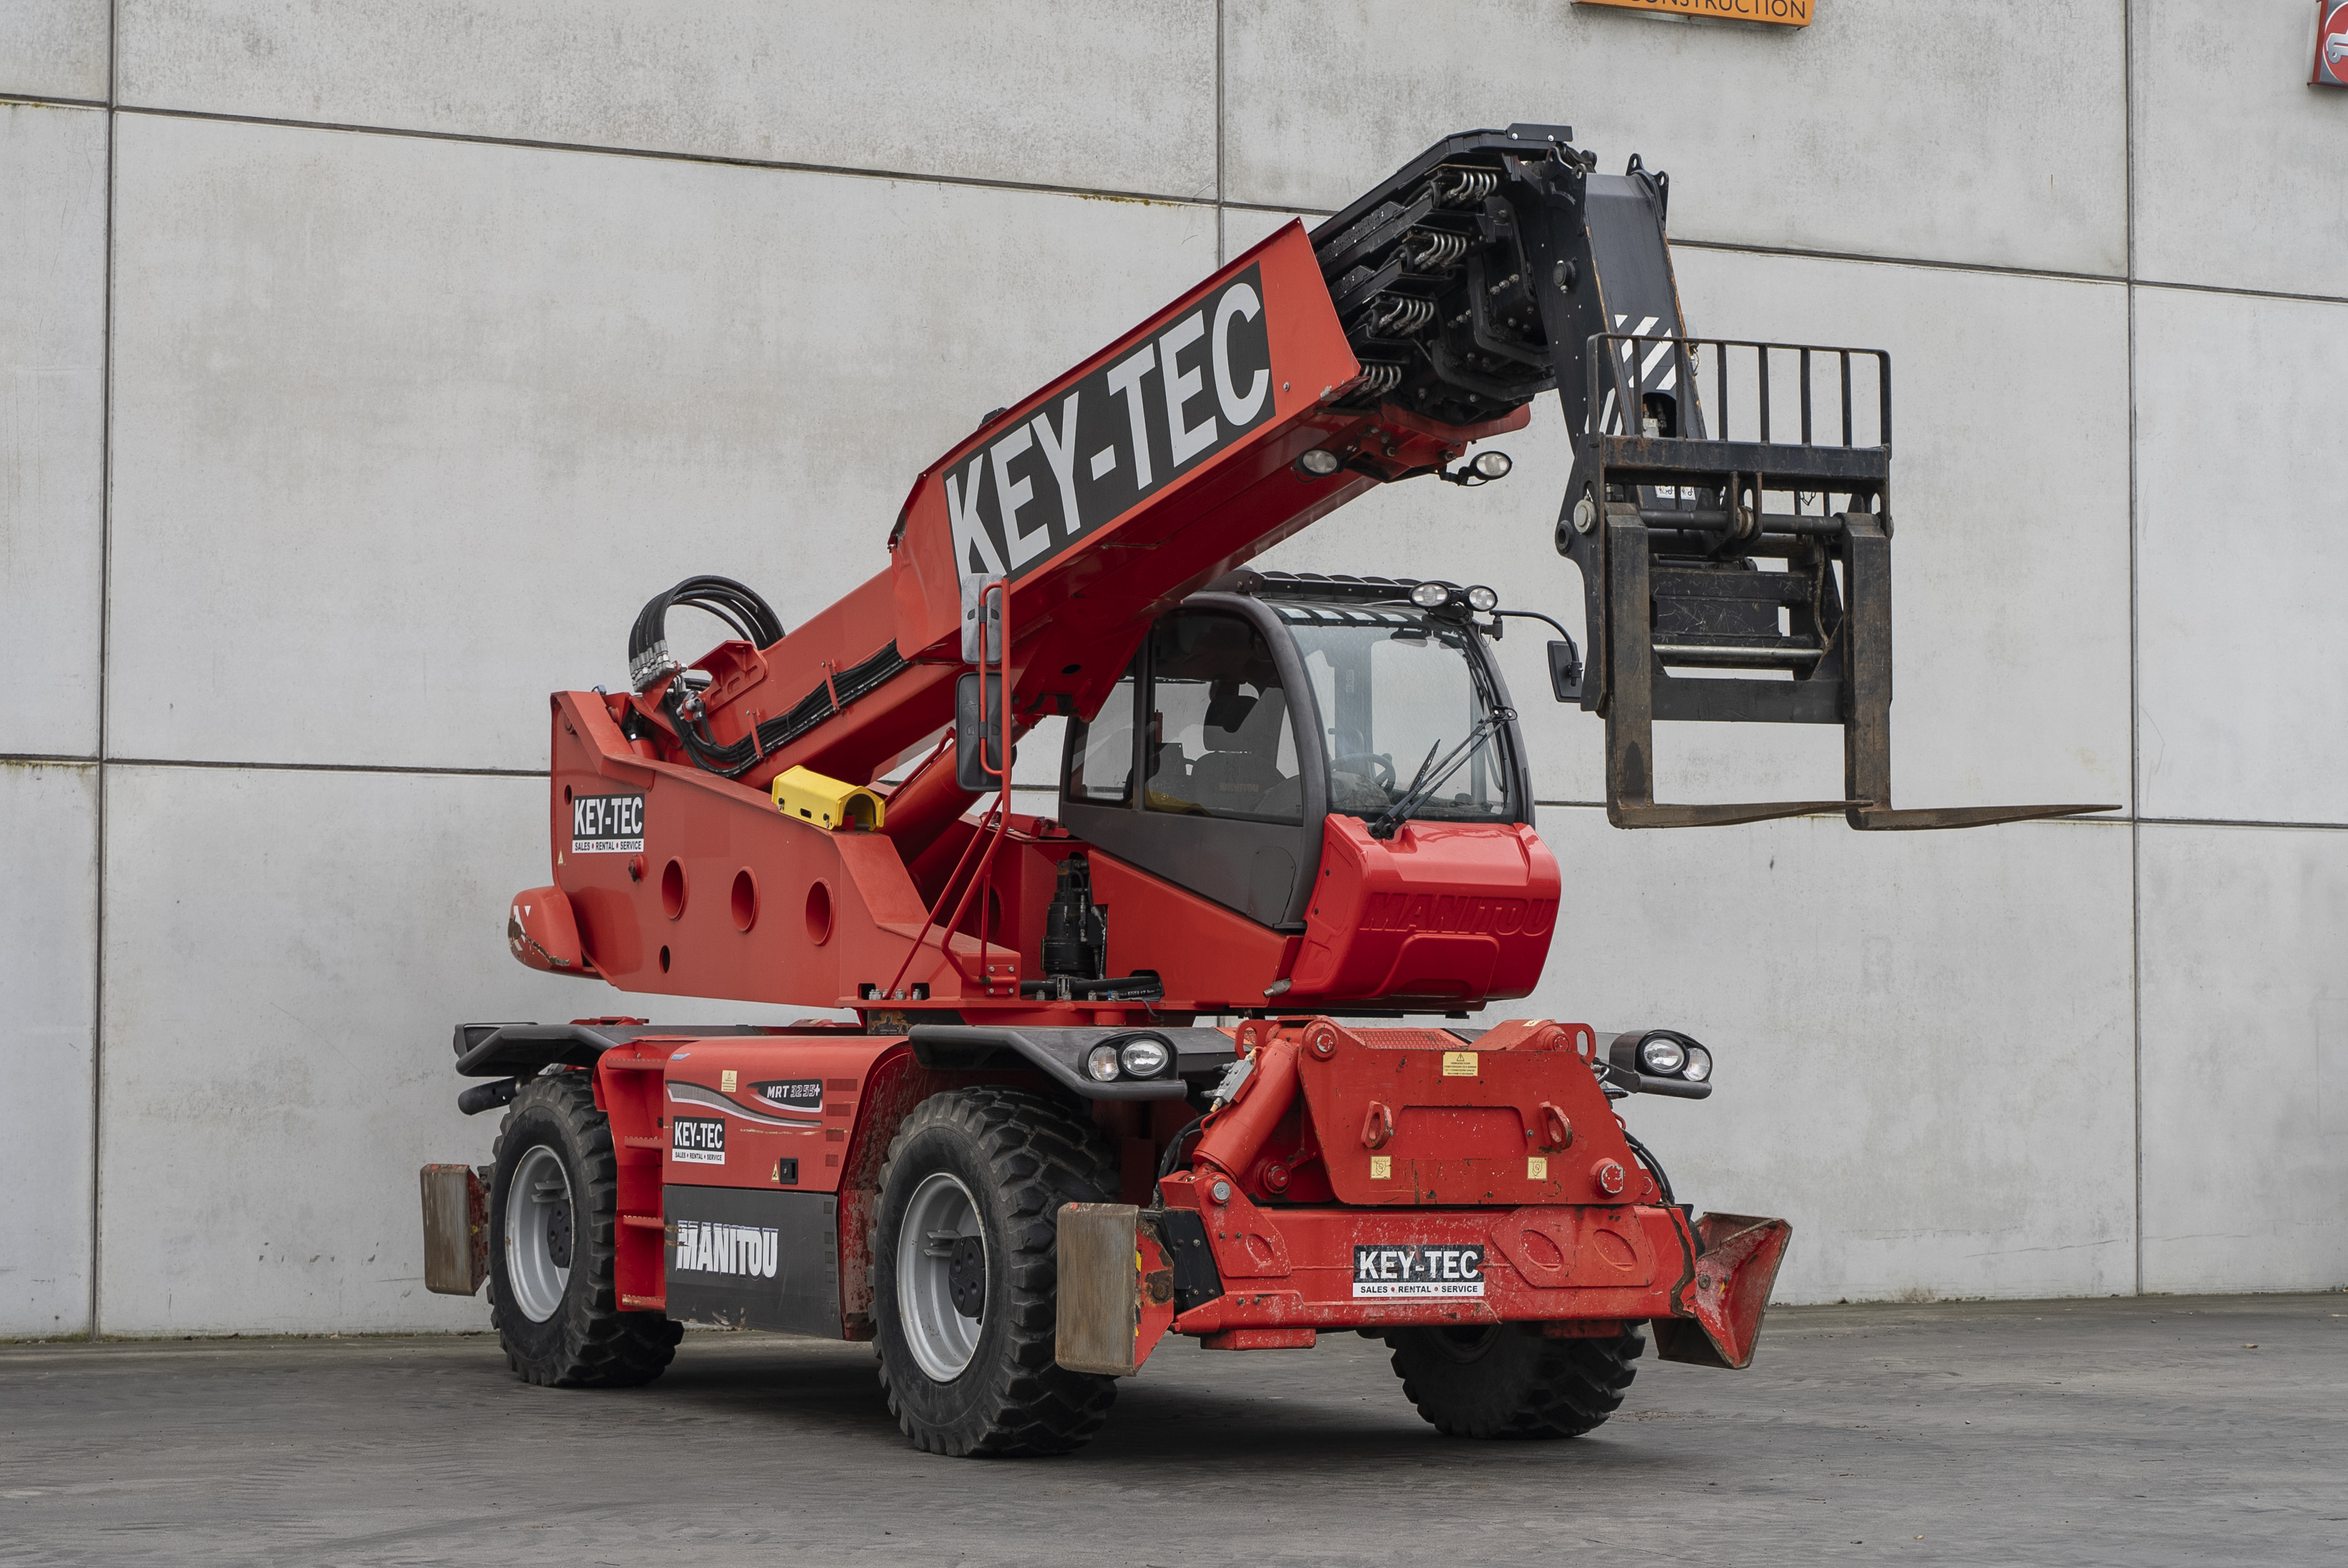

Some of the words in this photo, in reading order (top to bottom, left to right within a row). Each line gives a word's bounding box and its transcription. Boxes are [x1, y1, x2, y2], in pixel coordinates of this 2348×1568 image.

[1631, 0, 1805, 19] RUCTION
[946, 283, 1269, 579] KEY-TEC
[574, 797, 643, 835] KEY-TEC
[575, 842, 590, 851] SALES
[595, 841, 614, 851] RENTAL
[620, 841, 641, 850] SERVICE
[1359, 893, 1558, 936] MANITOU
[767, 1085, 790, 1098] MRT
[675, 1122, 722, 1149] KEY-TEC
[676, 1220, 779, 1279] MANITOU
[1359, 1250, 1479, 1279] KEY-TEC
